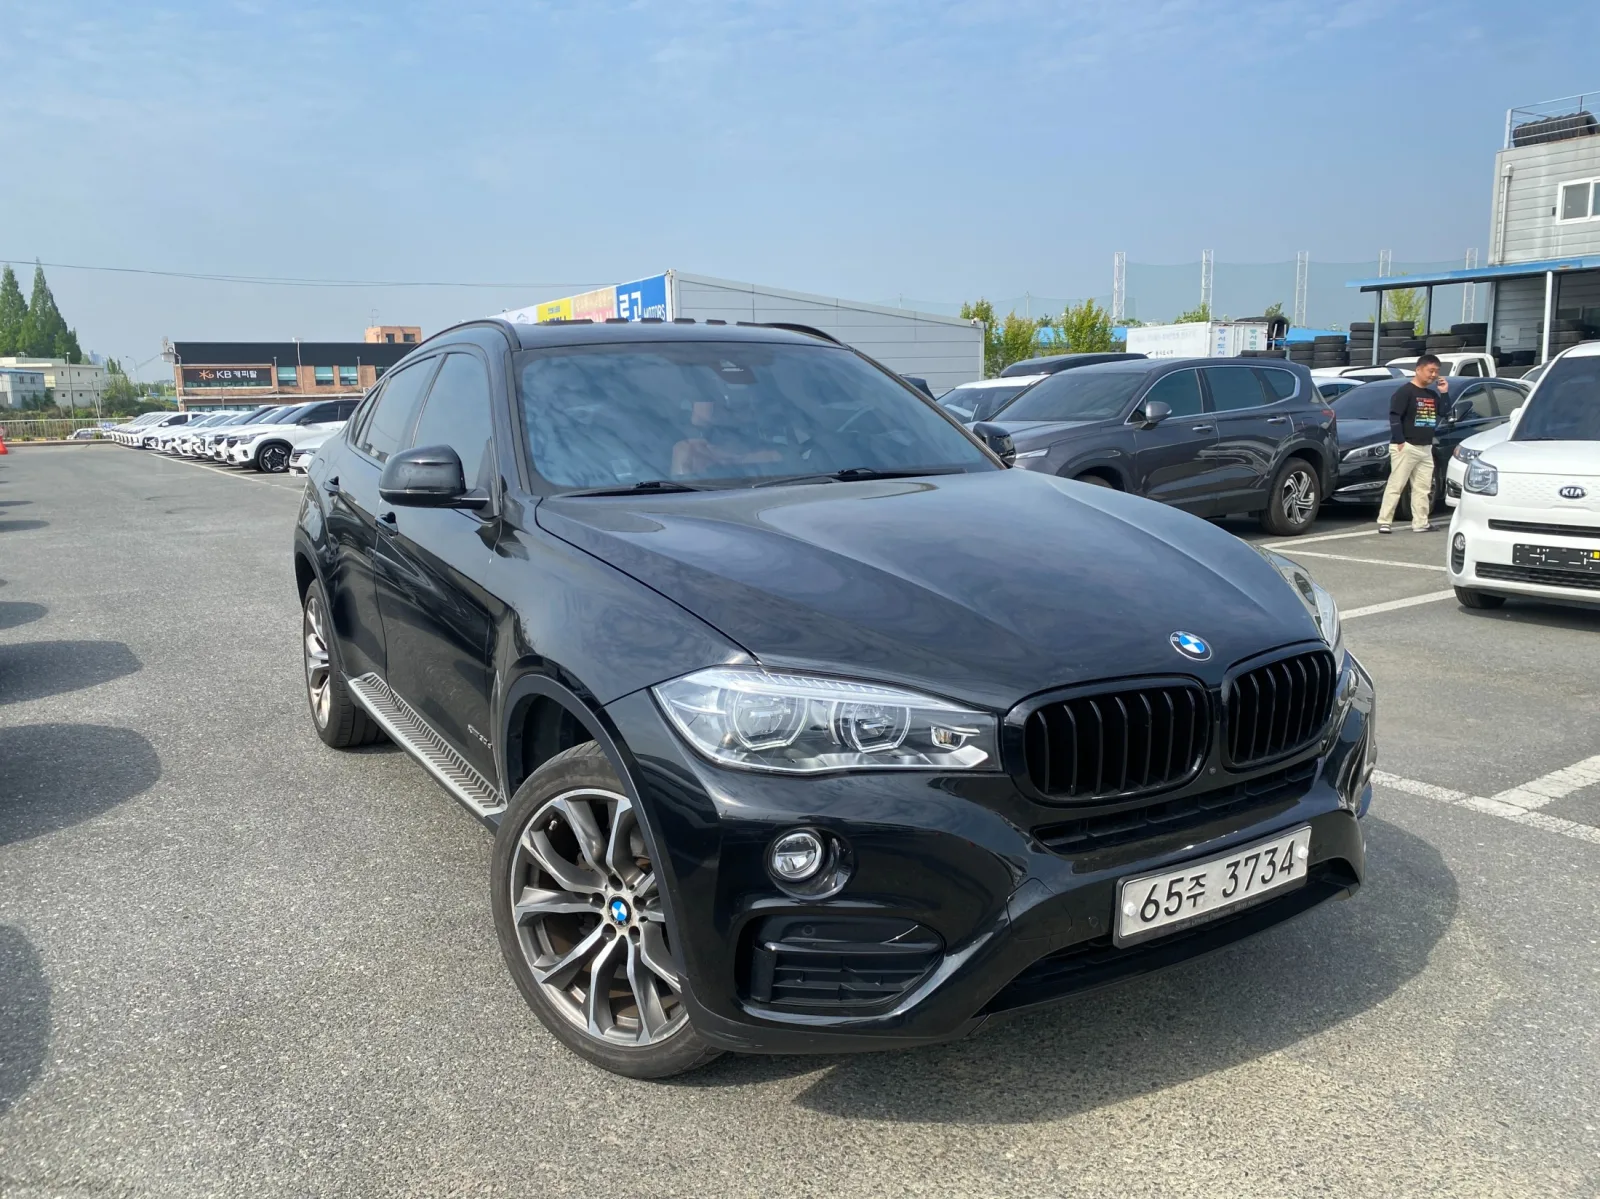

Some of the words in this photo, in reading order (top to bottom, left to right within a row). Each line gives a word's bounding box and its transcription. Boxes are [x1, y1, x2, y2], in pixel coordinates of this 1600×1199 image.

[216, 370, 232, 379] KB
[233, 370, 257, 379] 캐피탈
[1561, 487, 1582, 497] KIA
[1139, 873, 1207, 923] 65주
[1221, 840, 1295, 898] 3734
